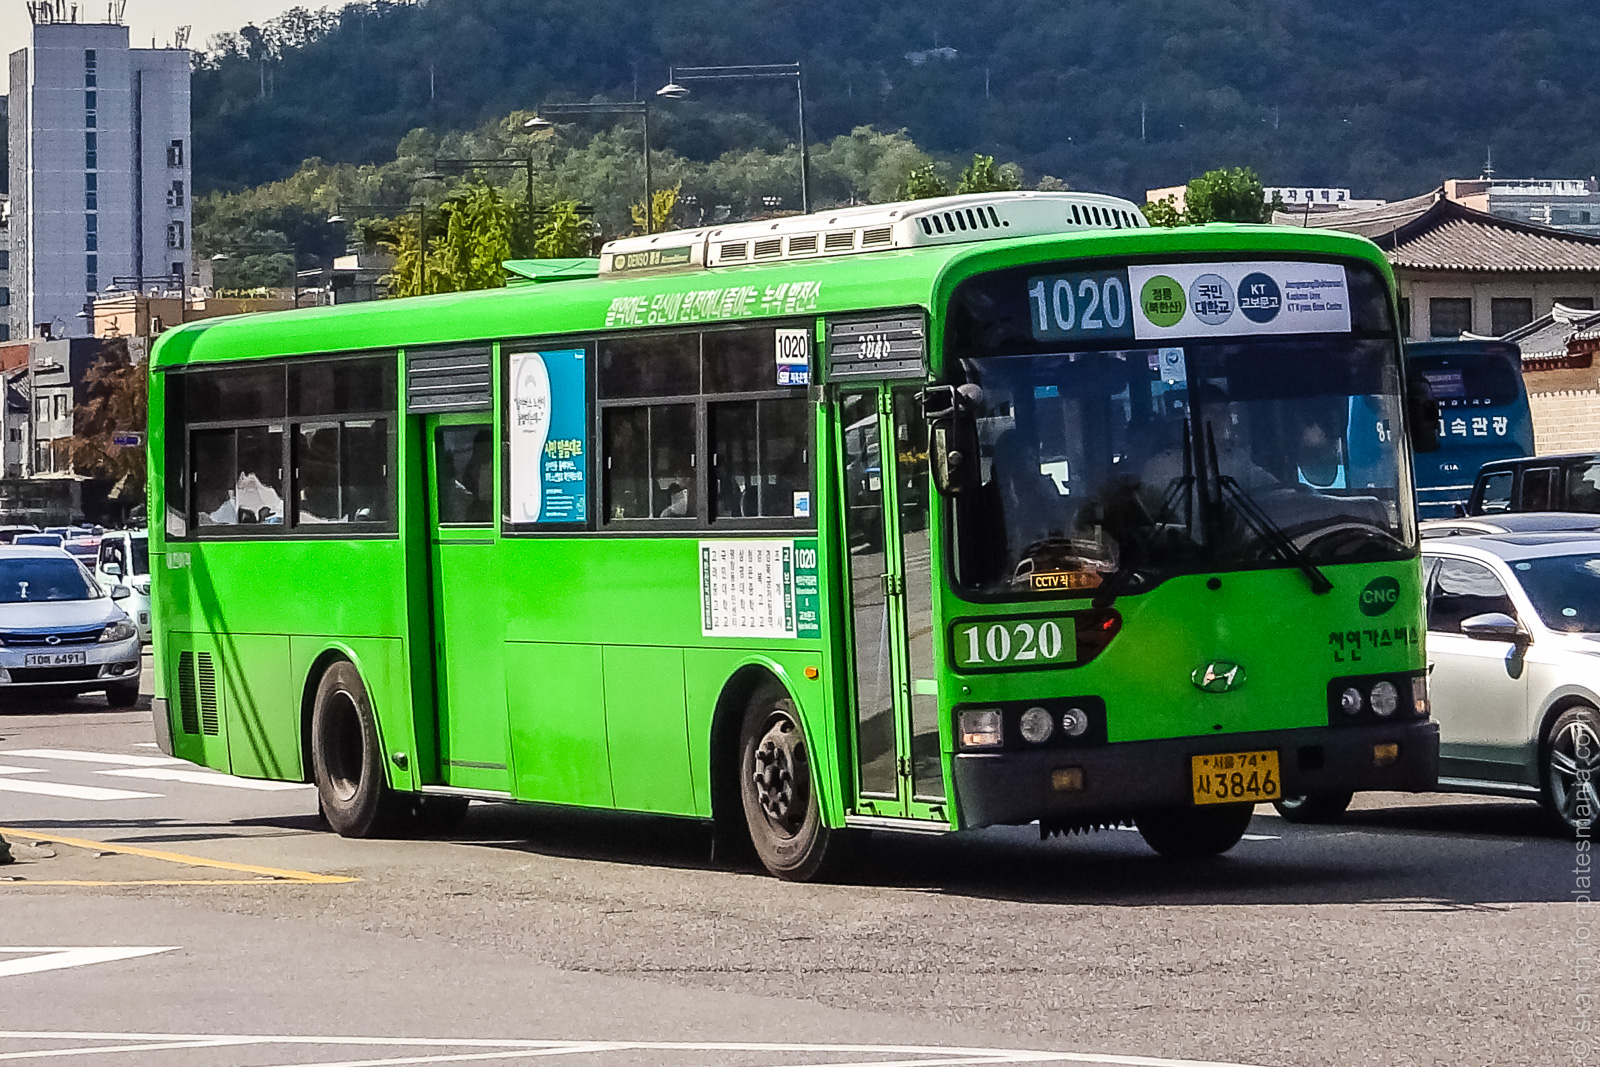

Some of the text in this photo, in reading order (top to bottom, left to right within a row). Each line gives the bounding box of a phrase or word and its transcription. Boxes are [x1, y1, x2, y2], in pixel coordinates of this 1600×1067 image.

[1198, 284, 1223, 299] 국민
[1250, 284, 1266, 295] KT
[1029, 277, 1127, 331] 1020
[1195, 300, 1231, 315] 대학교
[778, 335, 806, 358] 1020
[795, 549, 816, 569] 1020
[1035, 576, 1059, 587] CCTV
[1362, 588, 1396, 604] CNG
[962, 621, 1062, 663] 1020
[55, 654, 79, 664] 6491
